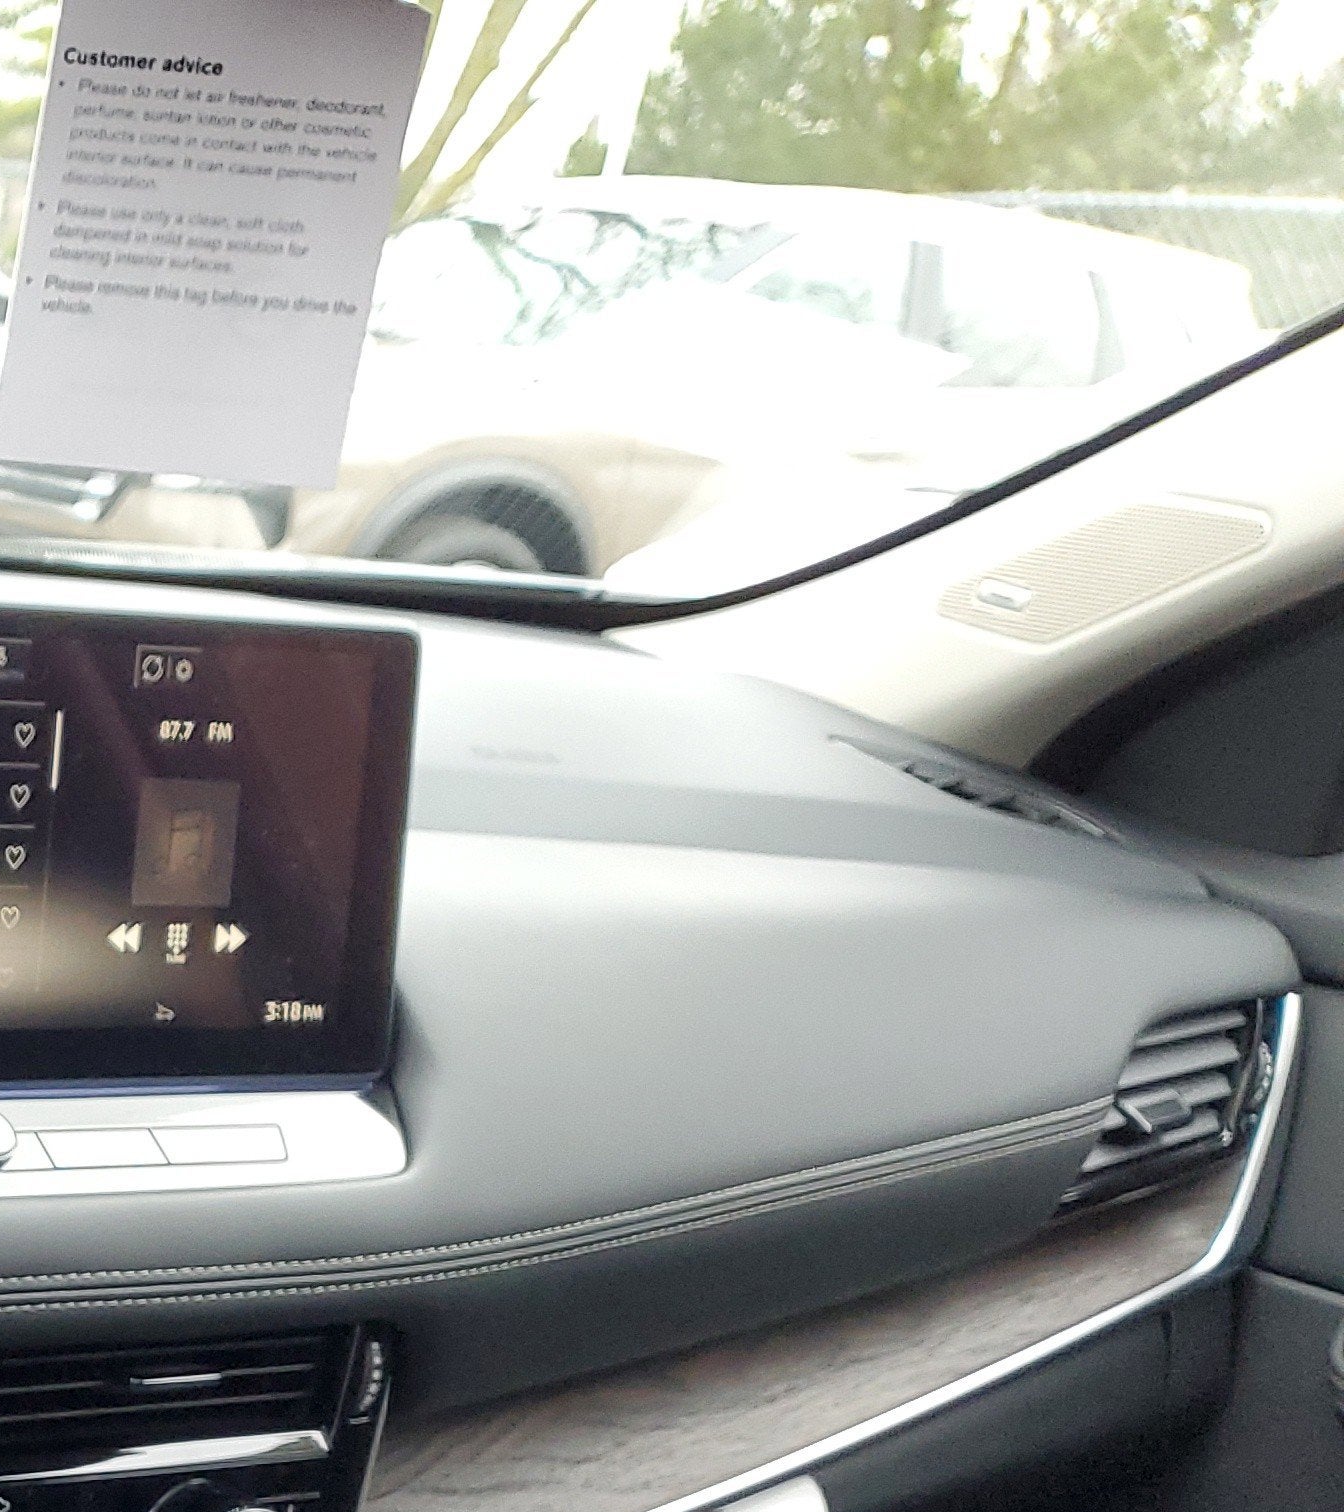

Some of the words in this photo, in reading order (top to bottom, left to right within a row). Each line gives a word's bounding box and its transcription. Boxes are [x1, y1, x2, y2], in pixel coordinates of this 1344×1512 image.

[64, 47, 157, 70] Customer
[163, 55, 224, 75] advice
[78, 77, 128, 95] Please
[132, 85, 151, 98] do
[155, 87, 179, 100] not
[57, 199, 108, 217] Please
[43, 274, 95, 293] Please
[160, 720, 195, 741] 87.7
[208, 721, 234, 742] FM
